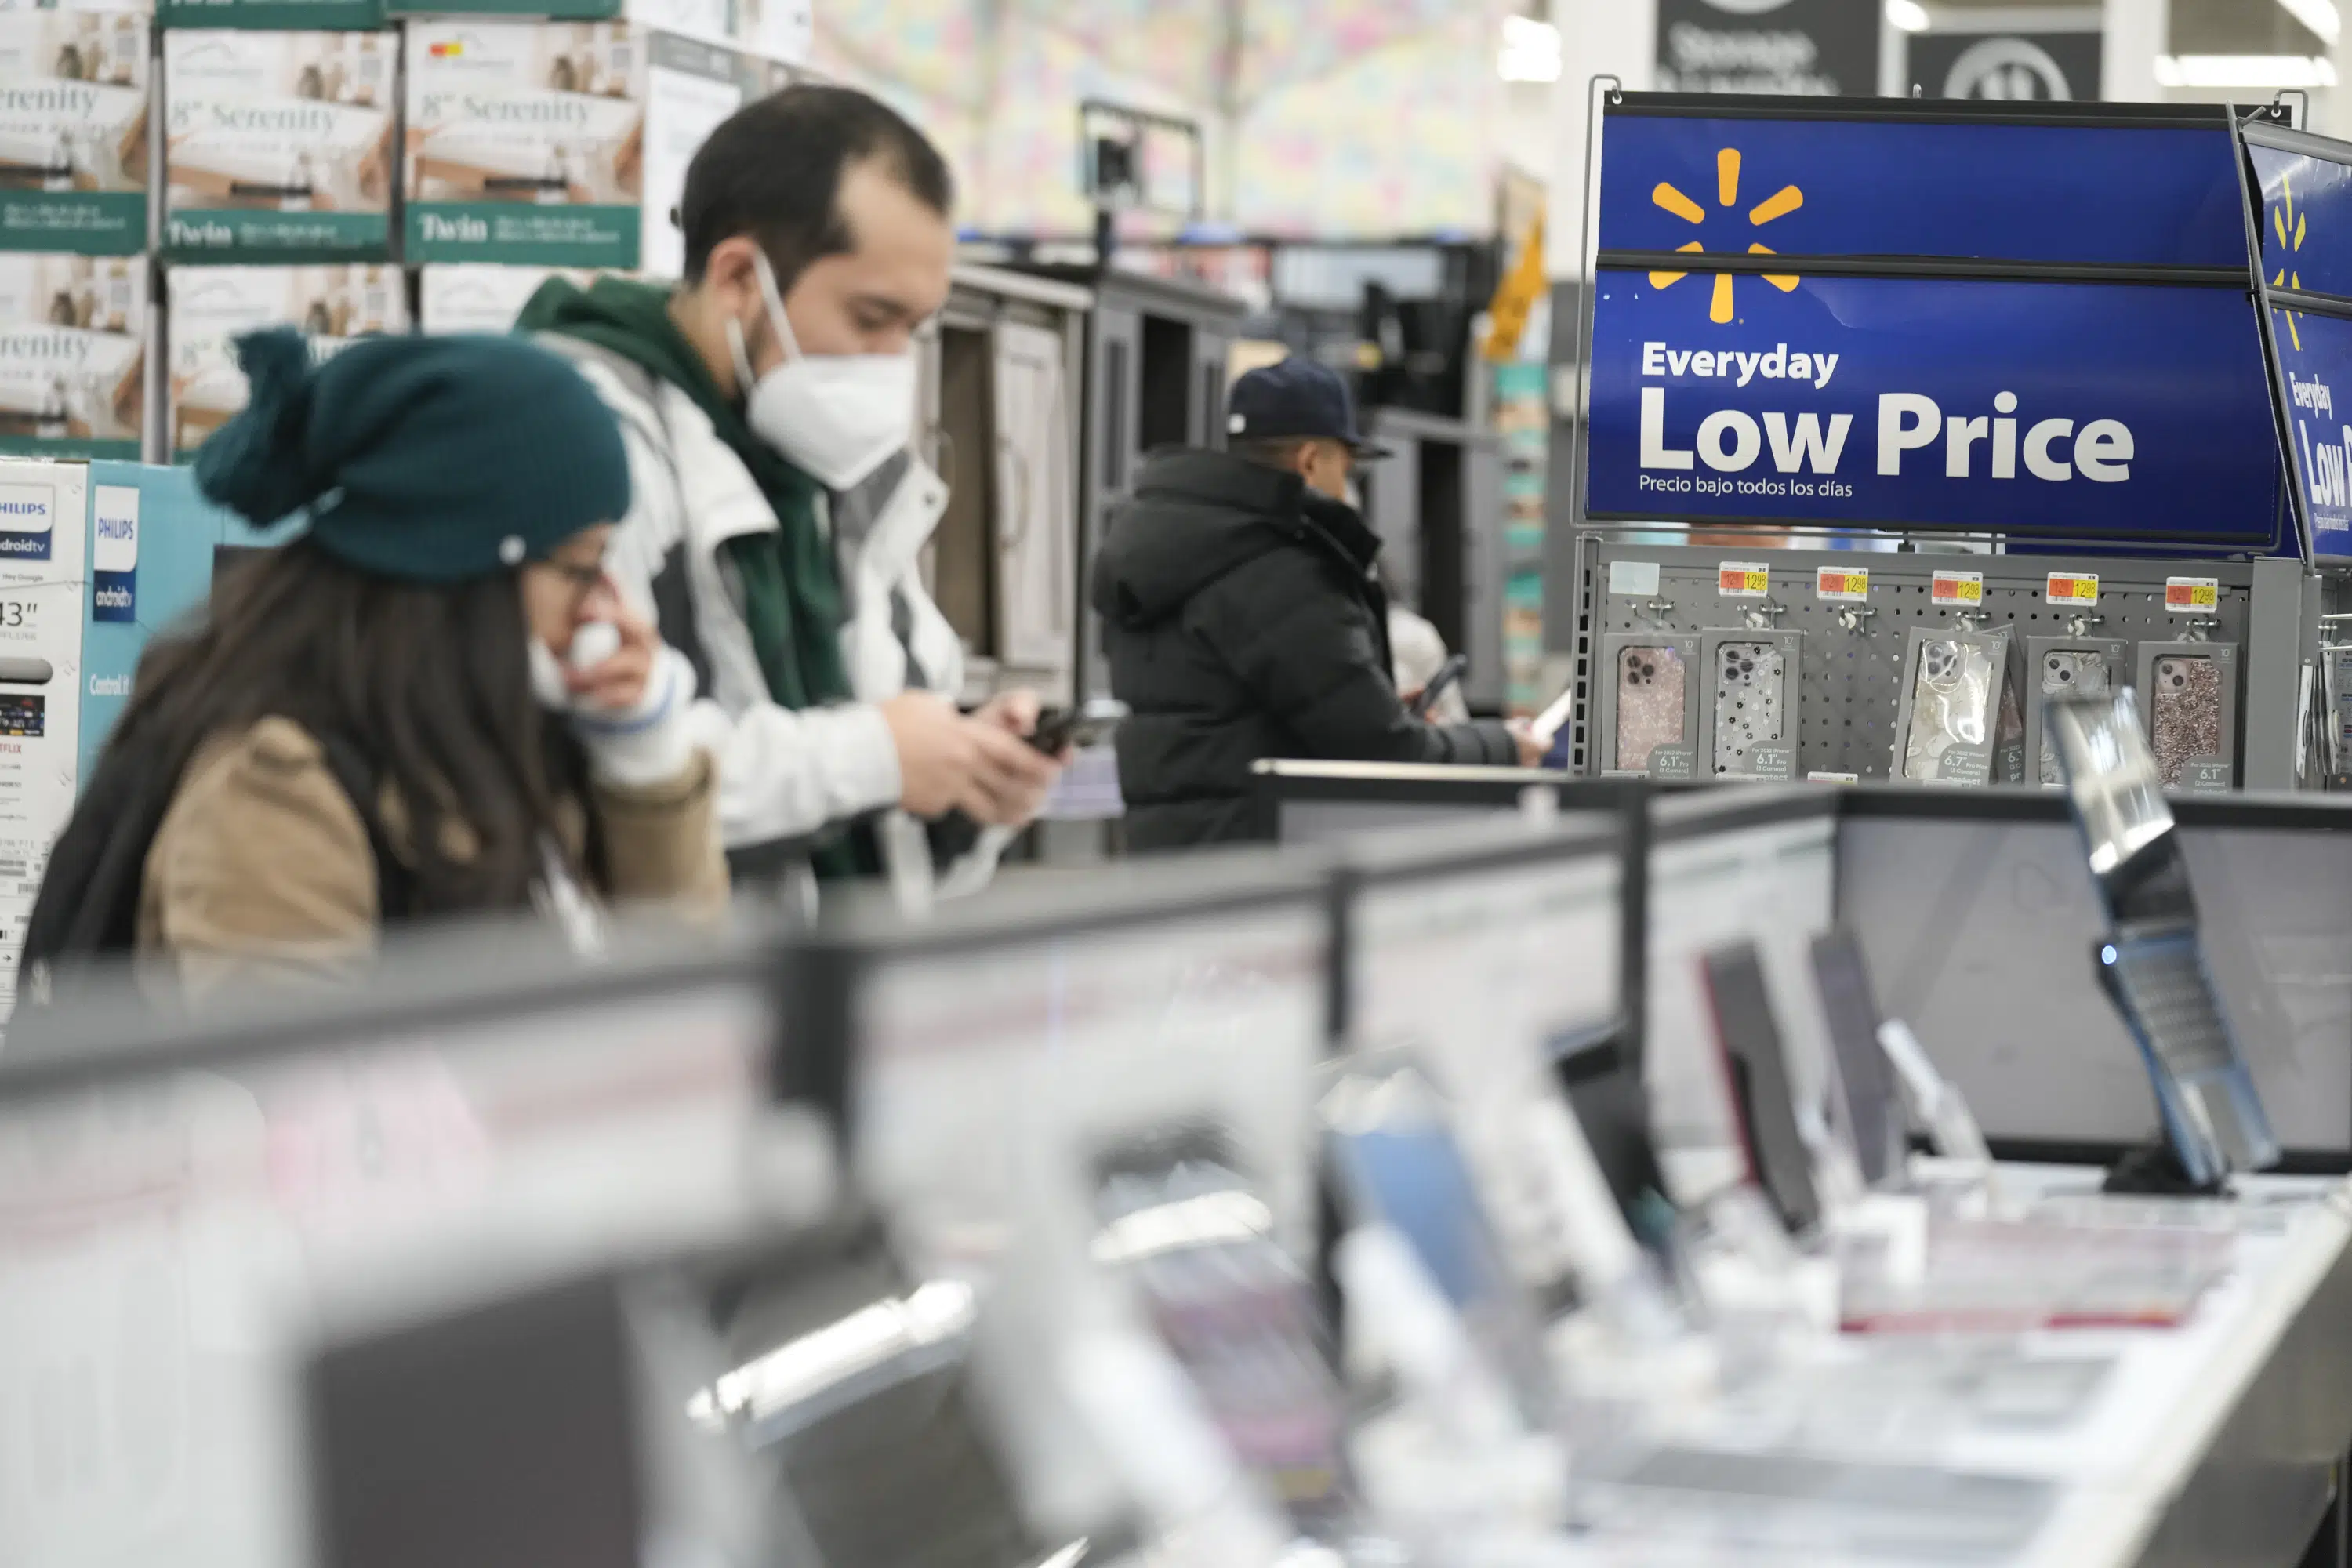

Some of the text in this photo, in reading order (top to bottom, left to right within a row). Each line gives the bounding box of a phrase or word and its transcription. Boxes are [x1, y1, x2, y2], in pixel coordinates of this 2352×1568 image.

[212, 101, 338, 138] Serenity
[463, 93, 590, 129] Serenity
[168, 220, 232, 246] Twin
[417, 213, 488, 243] Twin
[1642, 342, 1839, 390] Everyday
[2289, 372, 2333, 420] Everyday
[1640, 387, 2135, 482] Low Price
[2299, 419, 2346, 507] Low
[1640, 474, 1853, 497] Precio bajo todos los días
[98, 517, 134, 540] PHILIPS
